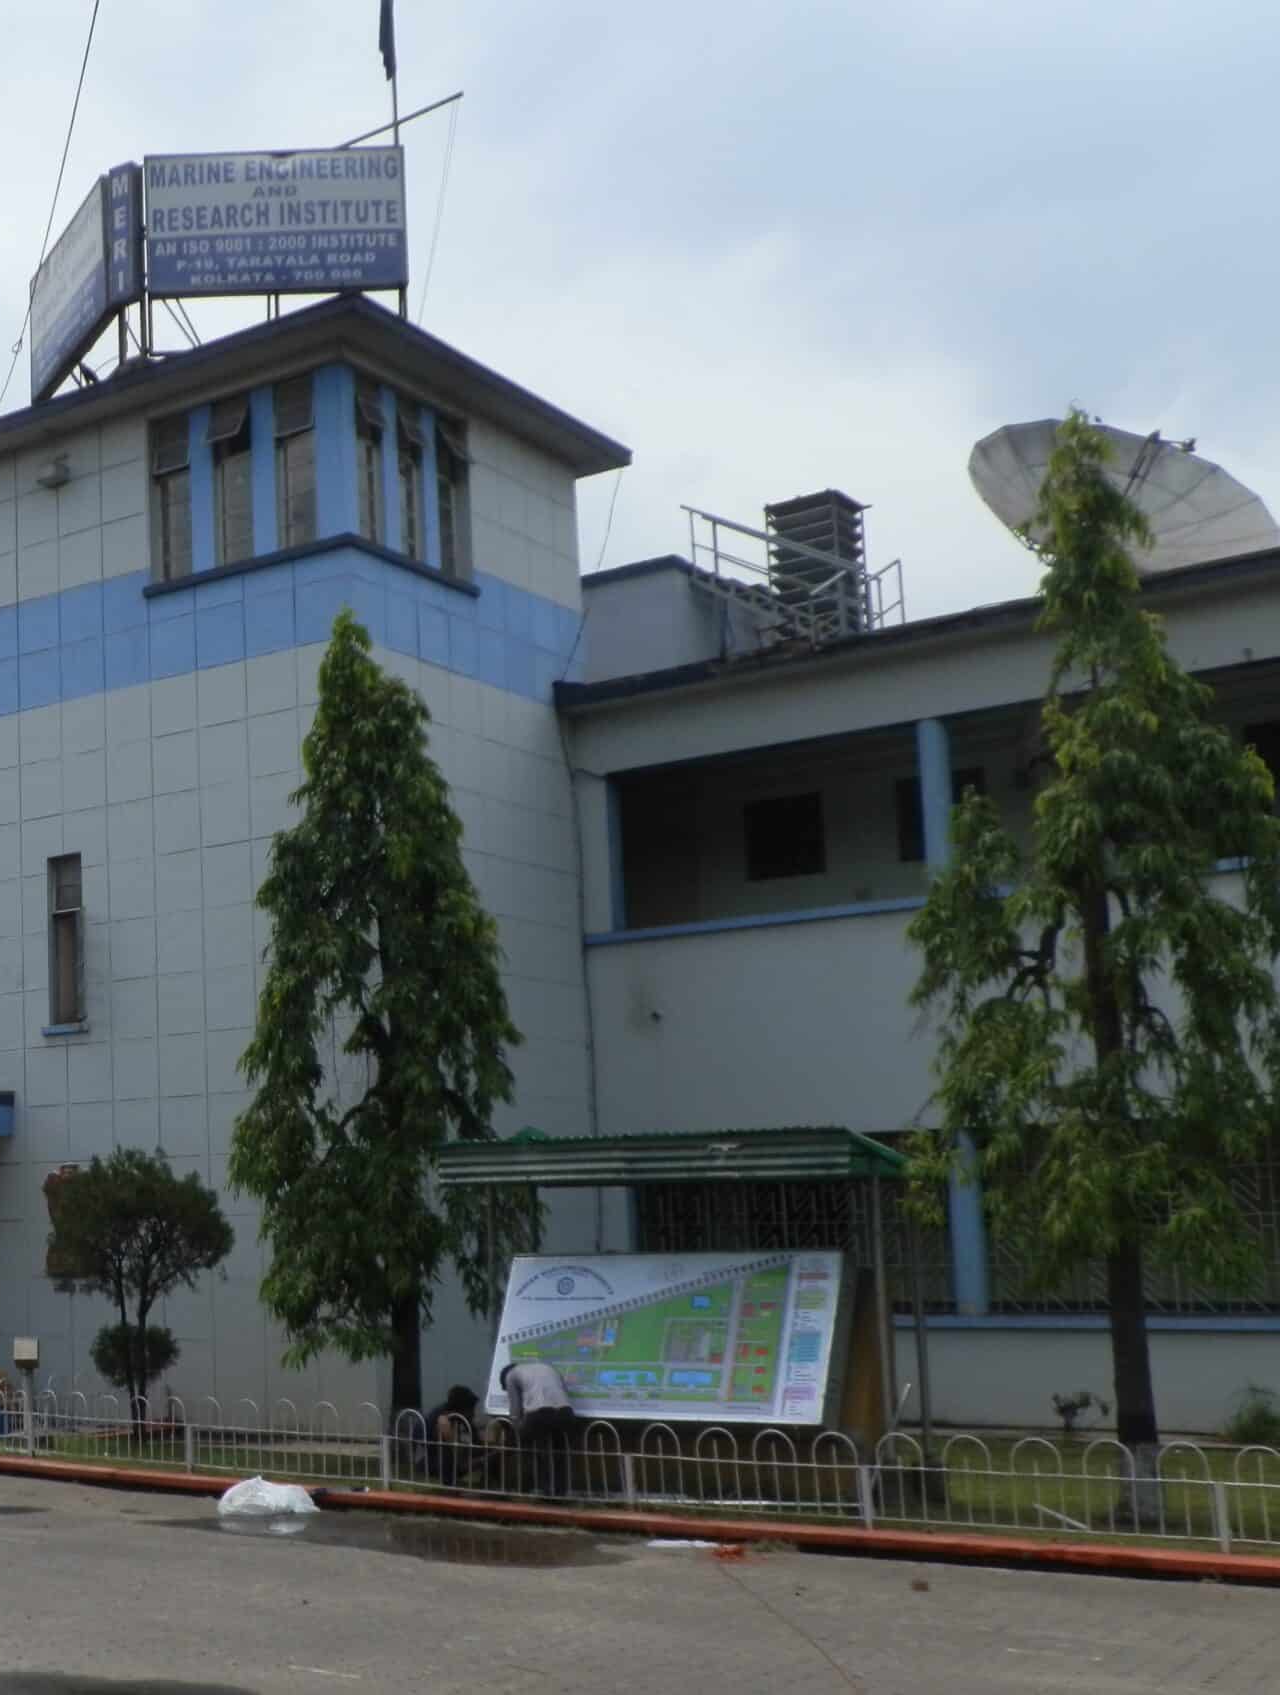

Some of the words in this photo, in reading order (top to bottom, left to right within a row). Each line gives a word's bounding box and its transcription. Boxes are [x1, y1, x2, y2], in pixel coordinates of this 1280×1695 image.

[150, 161, 236, 189] MARINE
[244, 154, 399, 183] ENGINEERING
[252, 185, 298, 199] AND
[152, 203, 271, 234] RESEARCH
[279, 199, 398, 228] INSTITUTE
[112, 176, 129, 294] MERI
[155, 240, 179, 257] AN
[183, 238, 211, 255] ISO
[268, 234, 308, 251] 2000
[311, 231, 398, 250] INSTITUTE
[326, 250, 377, 266] ROAD
[190, 271, 274, 286] KOLKATA
